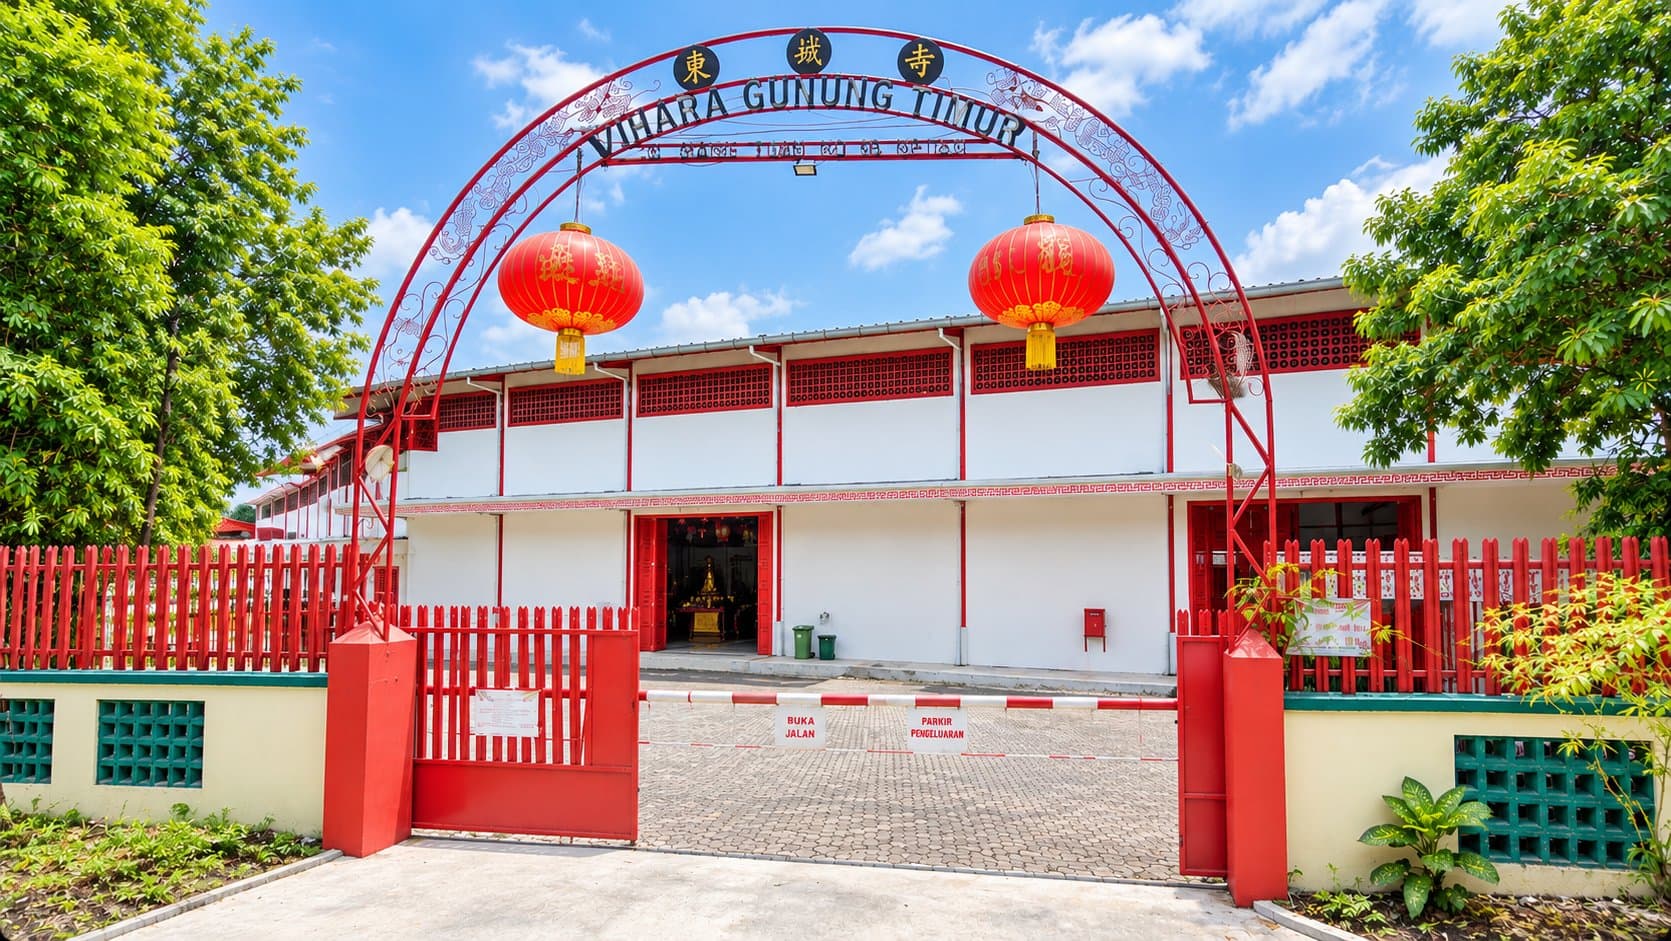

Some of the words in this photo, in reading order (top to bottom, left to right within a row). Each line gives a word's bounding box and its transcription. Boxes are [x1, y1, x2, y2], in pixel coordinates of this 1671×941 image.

[589, 86, 729, 158] VIHARA
[743, 76, 894, 112] GUNUNG
[912, 86, 1026, 146] TIMUR
[787, 716, 815, 725] BUKA
[921, 717, 952, 726] PARKIR
[785, 729, 815, 738] JALAN
